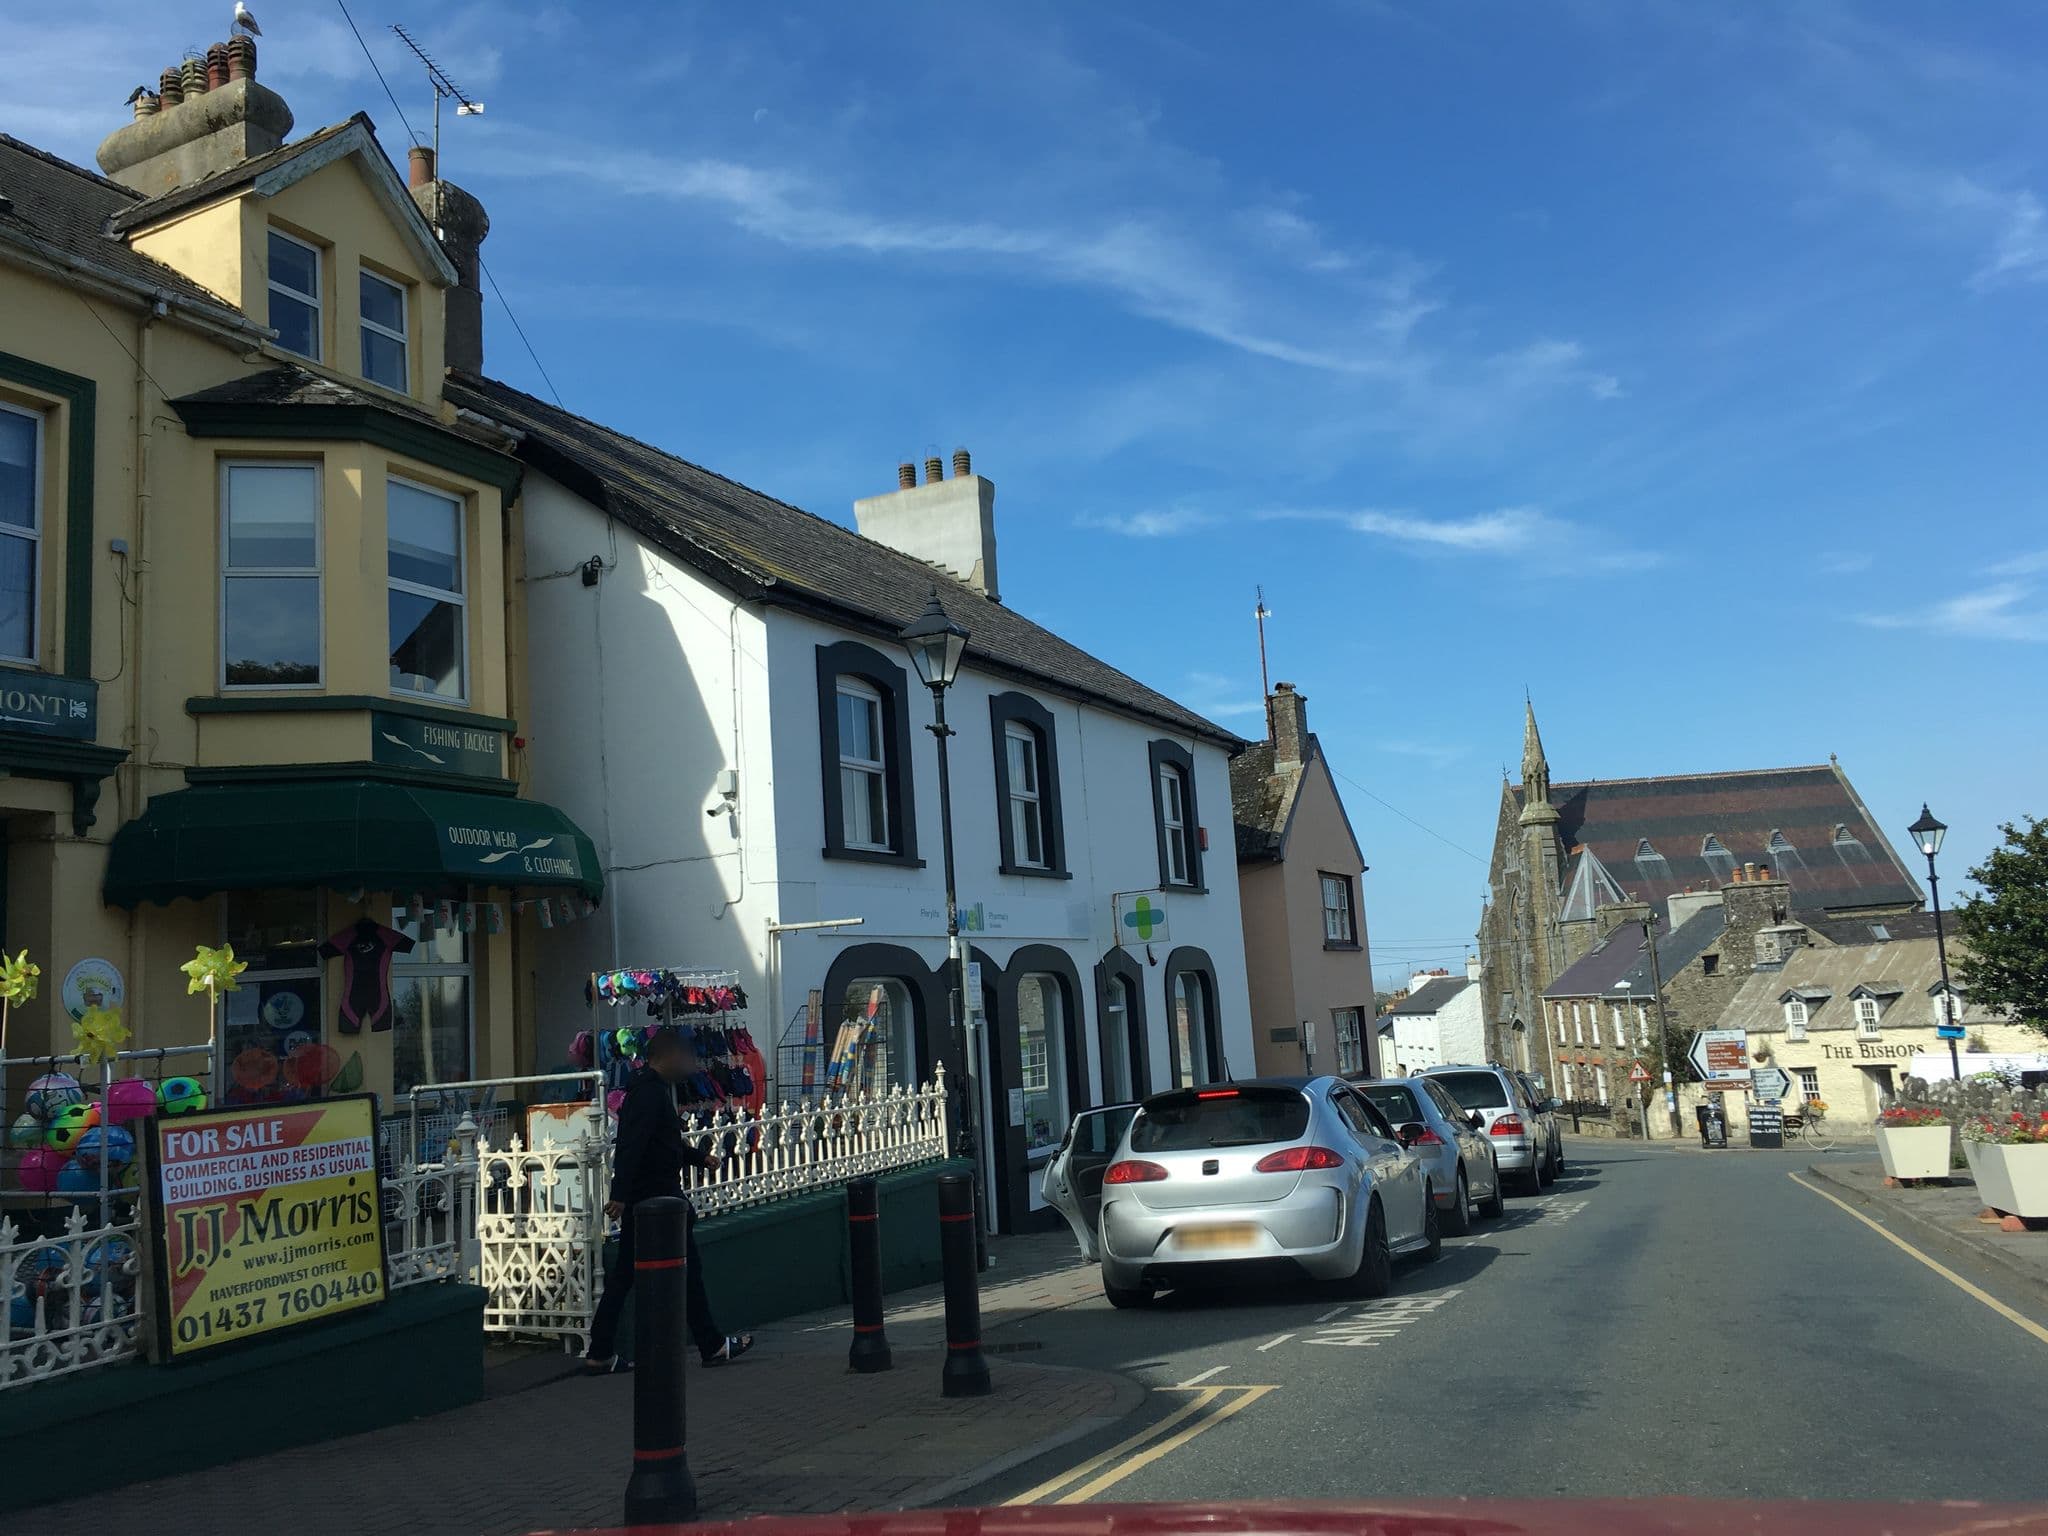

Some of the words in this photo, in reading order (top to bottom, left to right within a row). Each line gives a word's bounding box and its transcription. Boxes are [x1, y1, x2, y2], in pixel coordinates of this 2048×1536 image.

[0, 689, 66, 716] ONT
[423, 726, 461, 749] FISHING
[464, 732, 495, 753] TACKLE
[448, 826, 492, 846] OUTDOOR
[492, 831, 518, 848] WEAR
[524, 856, 533, 872] &
[535, 857, 575, 876] CLOTHING
[1821, 1044, 1854, 1059] THE
[1859, 1043, 1925, 1059] BISHOPS
[167, 1128, 220, 1159] FOR
[226, 1120, 284, 1150] SALE
[165, 1157, 257, 1182] COMMERCIAL
[261, 1151, 289, 1168] AND
[293, 1140, 371, 1163] RESIDENTIAL
[170, 1178, 242, 1200] BUILDING.
[244, 1167, 306, 1188] BUSINESS
[310, 1164, 326, 1178] AS
[329, 1157, 368, 1175] USUAL
[177, 1207, 232, 1274] J.J.
[239, 1177, 374, 1247] Morris
[243, 1232, 375, 1270] www.jjmorris.com
[210, 1270, 309, 1302] HAVERFORDWEST
[311, 1259, 348, 1277] OFFICE
[178, 1298, 267, 1342] 01437
[278, 1271, 378, 1318] 760440
